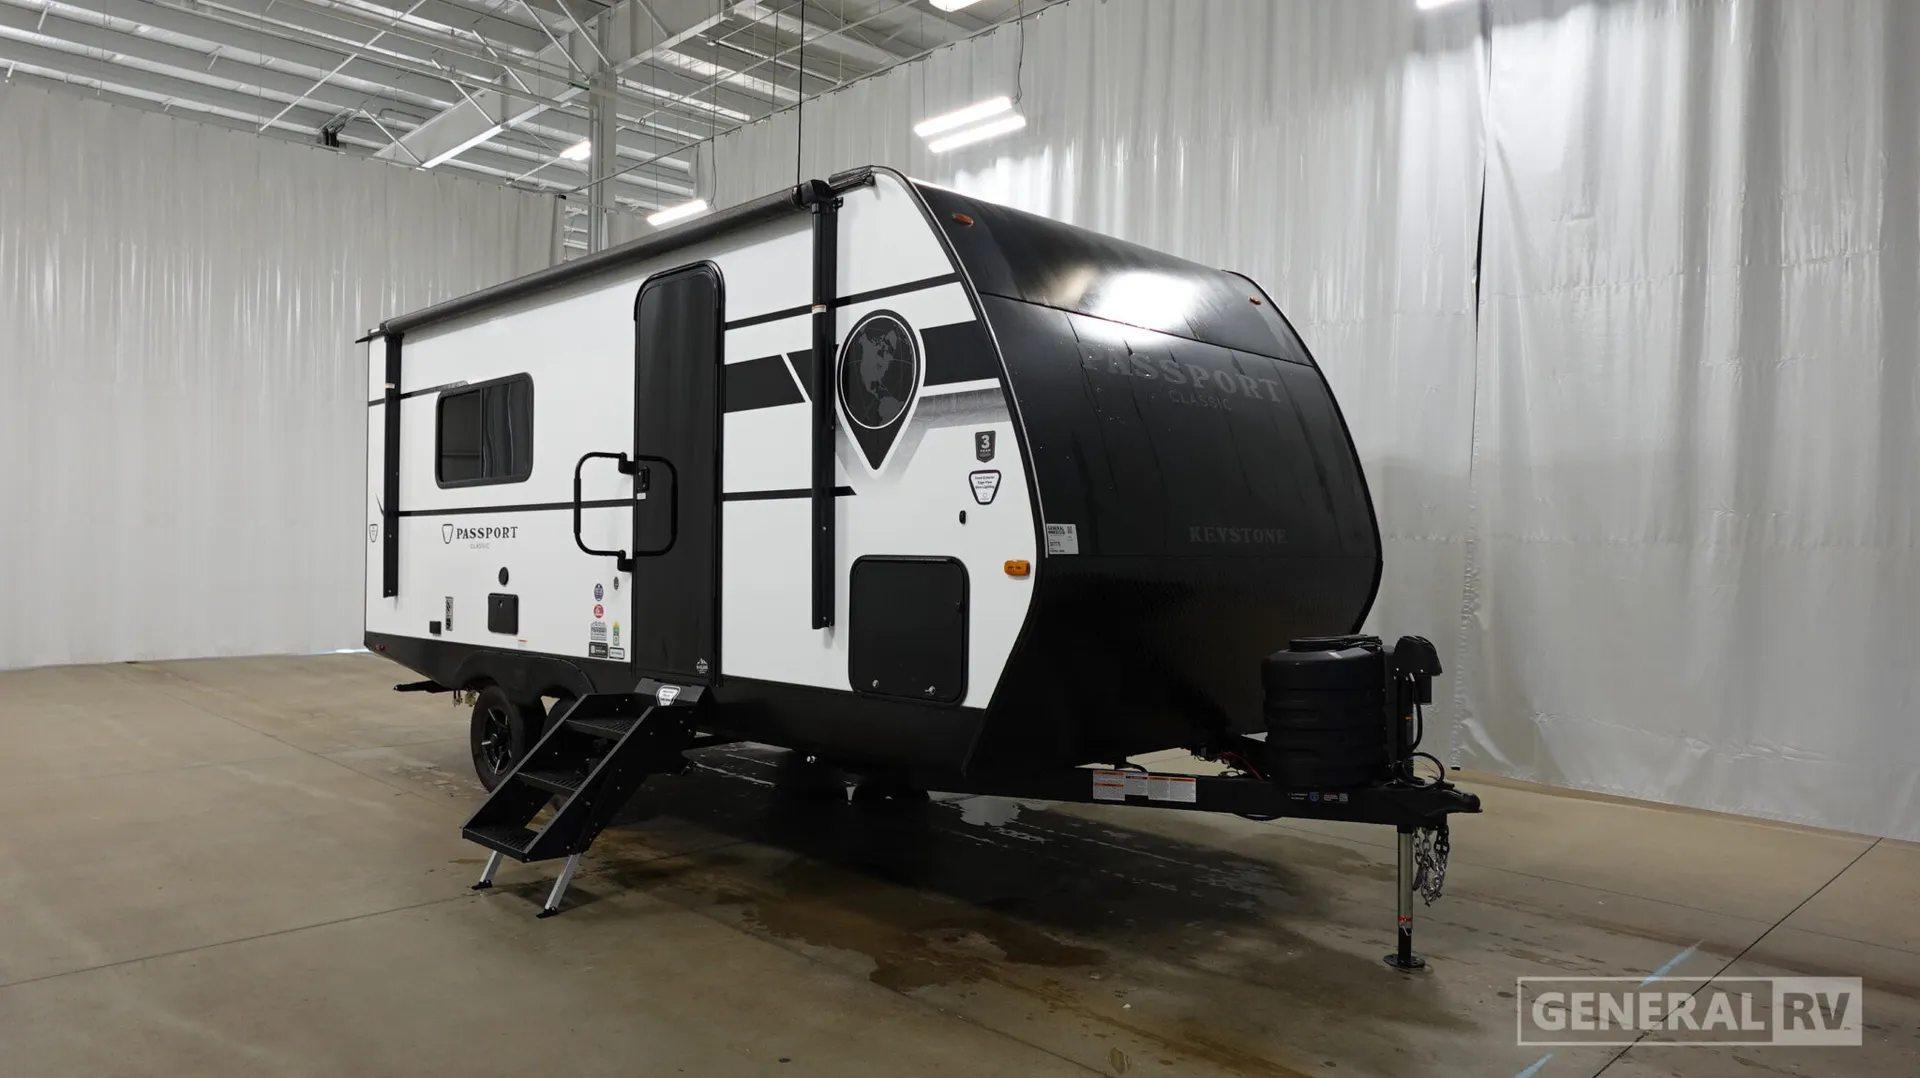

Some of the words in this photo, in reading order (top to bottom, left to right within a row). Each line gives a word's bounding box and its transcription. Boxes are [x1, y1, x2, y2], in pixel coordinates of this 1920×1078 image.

[1168, 389, 1233, 412] CLASSIC
[981, 434, 990, 449] 3
[456, 526, 518, 540] PASSPORT
[1188, 526, 1288, 545] KEYSTONE
